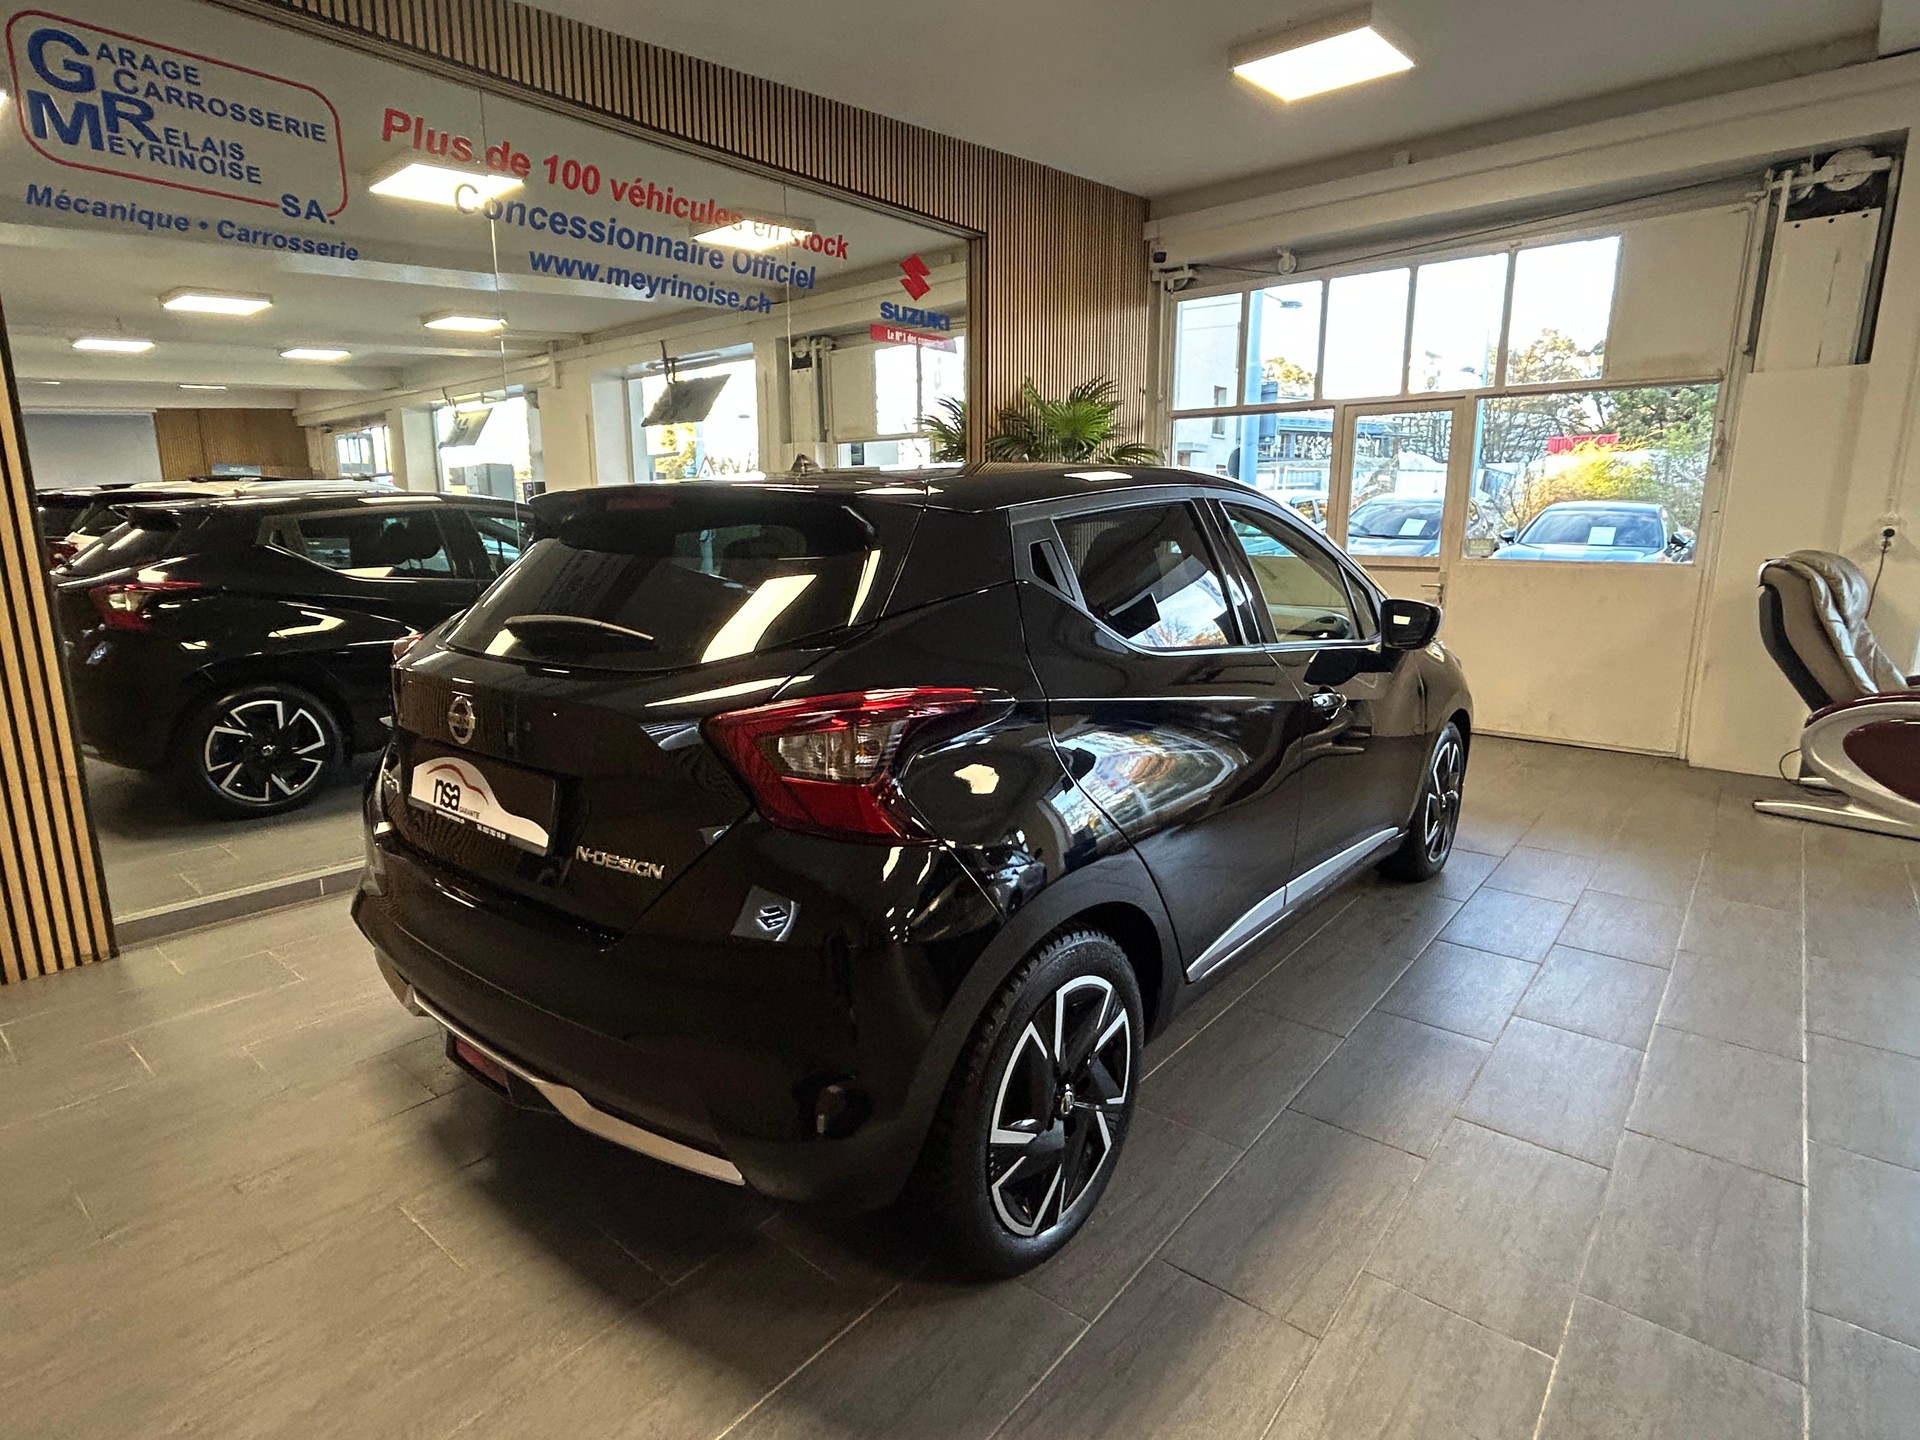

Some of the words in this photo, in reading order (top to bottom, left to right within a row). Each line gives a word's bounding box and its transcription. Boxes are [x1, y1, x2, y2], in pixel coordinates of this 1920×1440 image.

[27, 28, 201, 94] GARAGE
[26, 89, 263, 186] MEYRINOISE
[101, 90, 246, 162] RELAIS
[113, 69, 328, 143] CARROSSERIE
[382, 107, 473, 163] Plus
[485, 141, 531, 178] de
[543, 154, 601, 196] 100
[610, 177, 743, 232] véhicules
[790, 226, 849, 260] stock
[26, 183, 190, 233] Mécanique
[216, 219, 360, 262] Carrosserie
[455, 183, 724, 270] Concessionnaire
[732, 249, 816, 290] Officiel
[529, 250, 773, 314] www.meyrinoise.ch
[880, 301, 950, 331] SUZUKI
[433, 778, 461, 811] nsa
[575, 845, 665, 880] N-DESIGN
